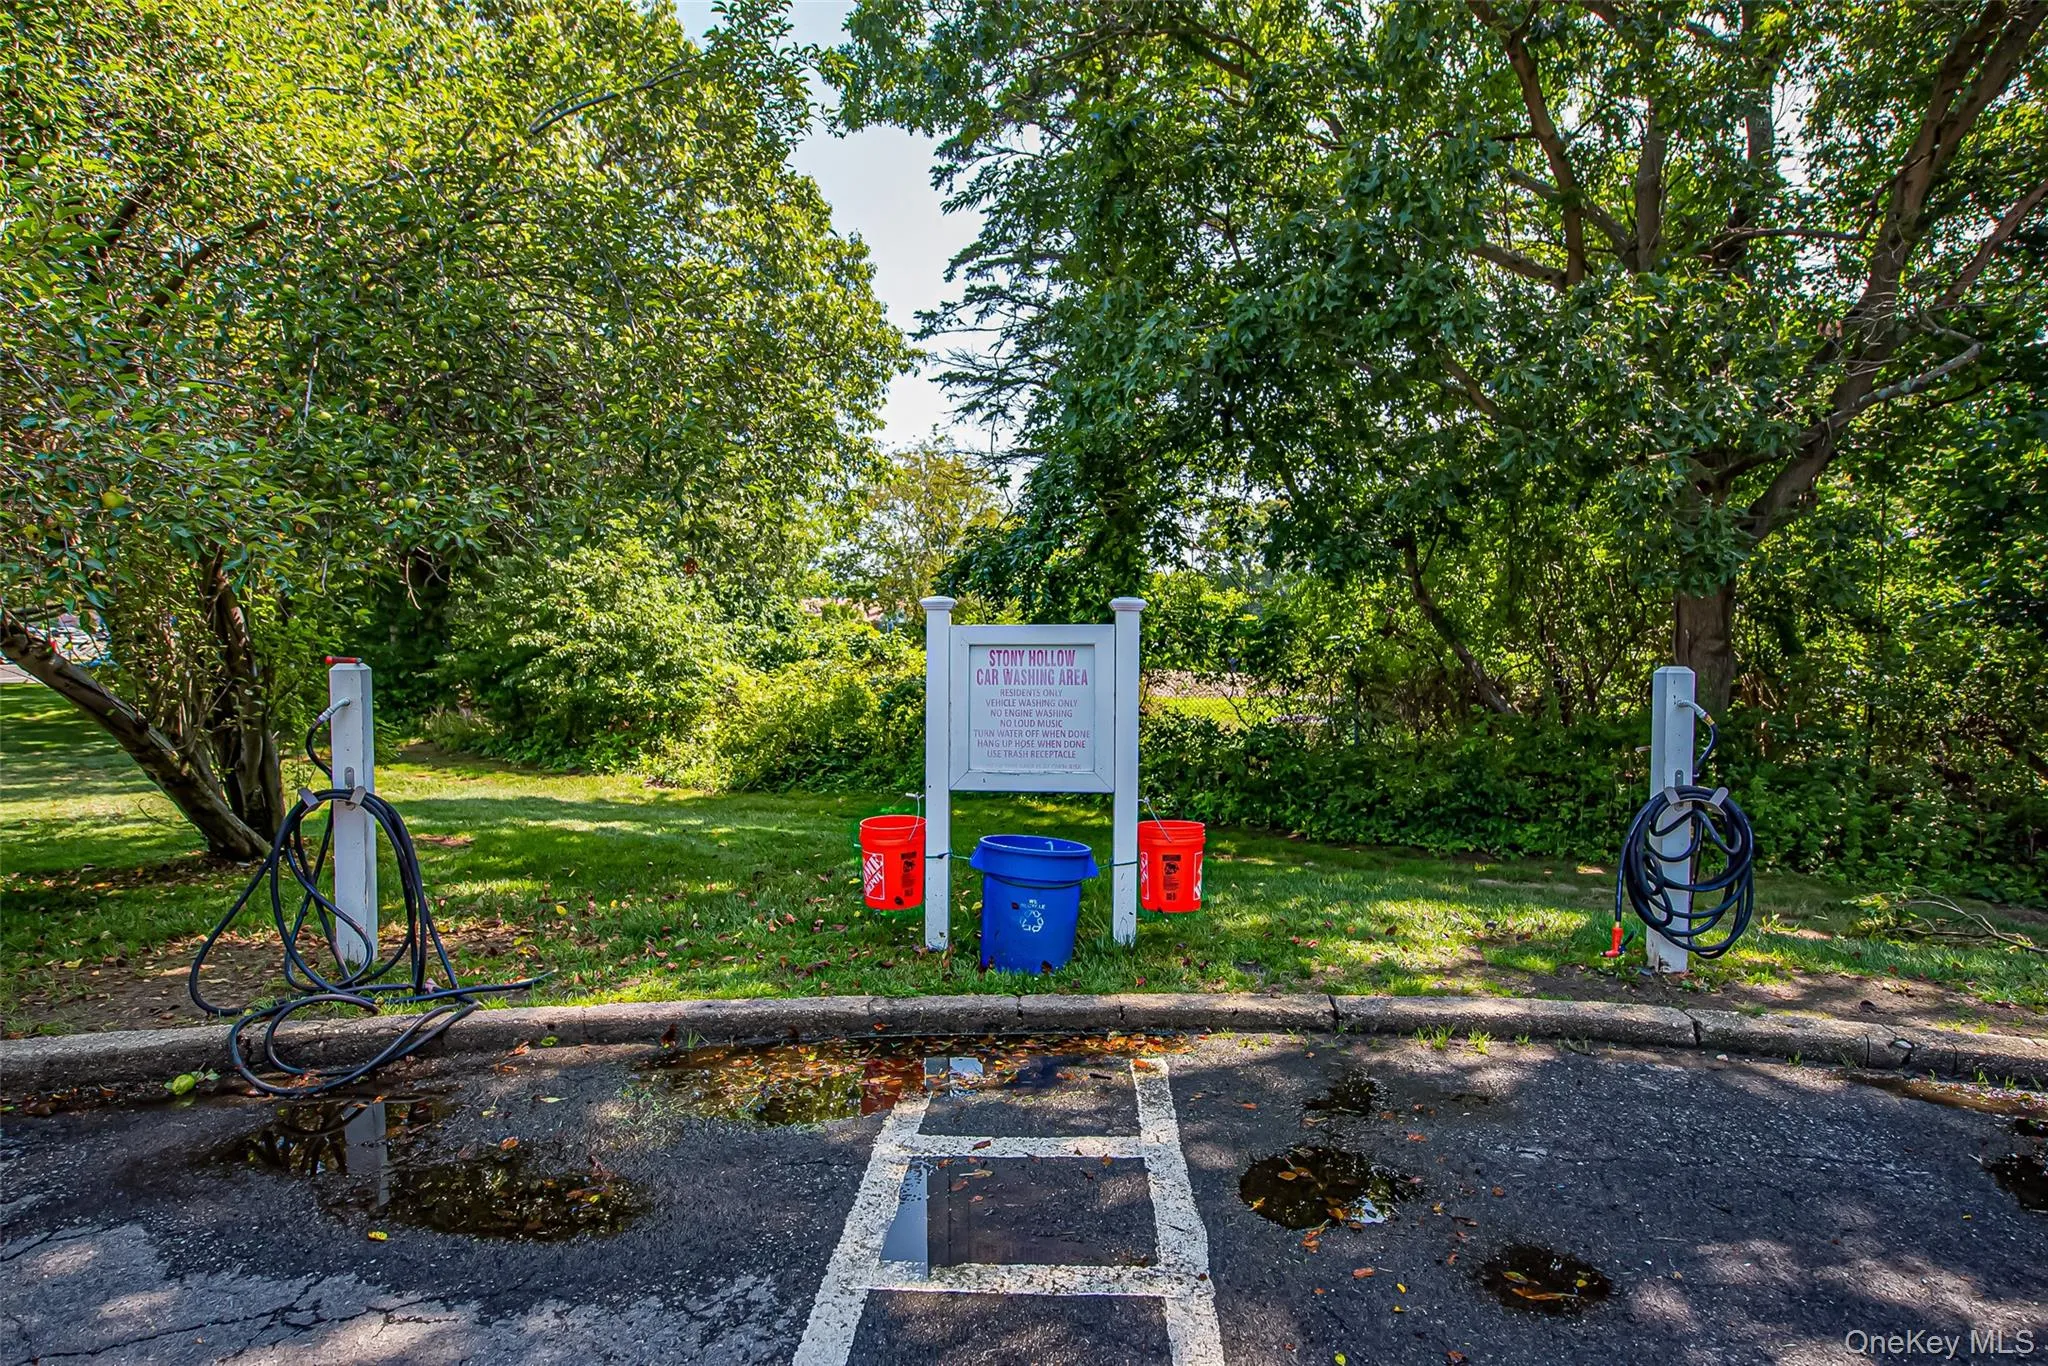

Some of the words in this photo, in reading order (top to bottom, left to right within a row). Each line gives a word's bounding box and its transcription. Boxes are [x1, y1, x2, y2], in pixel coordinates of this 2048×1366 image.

[989, 650, 1024, 666] STONY
[1029, 650, 1075, 666] HOLLOW
[977, 669, 998, 685] CAR
[1003, 669, 1054, 685] WASHING
[1059, 669, 1088, 685] AREA
[986, 699, 1016, 707] VEHICLE
[1018, 699, 1056, 707] WASHING
[1058, 699, 1078, 707] ONLY
[974, 730, 995, 738] TURN
[998, 730, 1023, 738] WATER
[1025, 730, 1039, 738] OFF
[1042, 730, 1065, 738] WHEN
[1068, 730, 1090, 738] DONE
[987, 750, 1001, 758] USE
[1004, 750, 1028, 758] TRASH
[1031, 750, 1076, 758] RECEPTACLE
